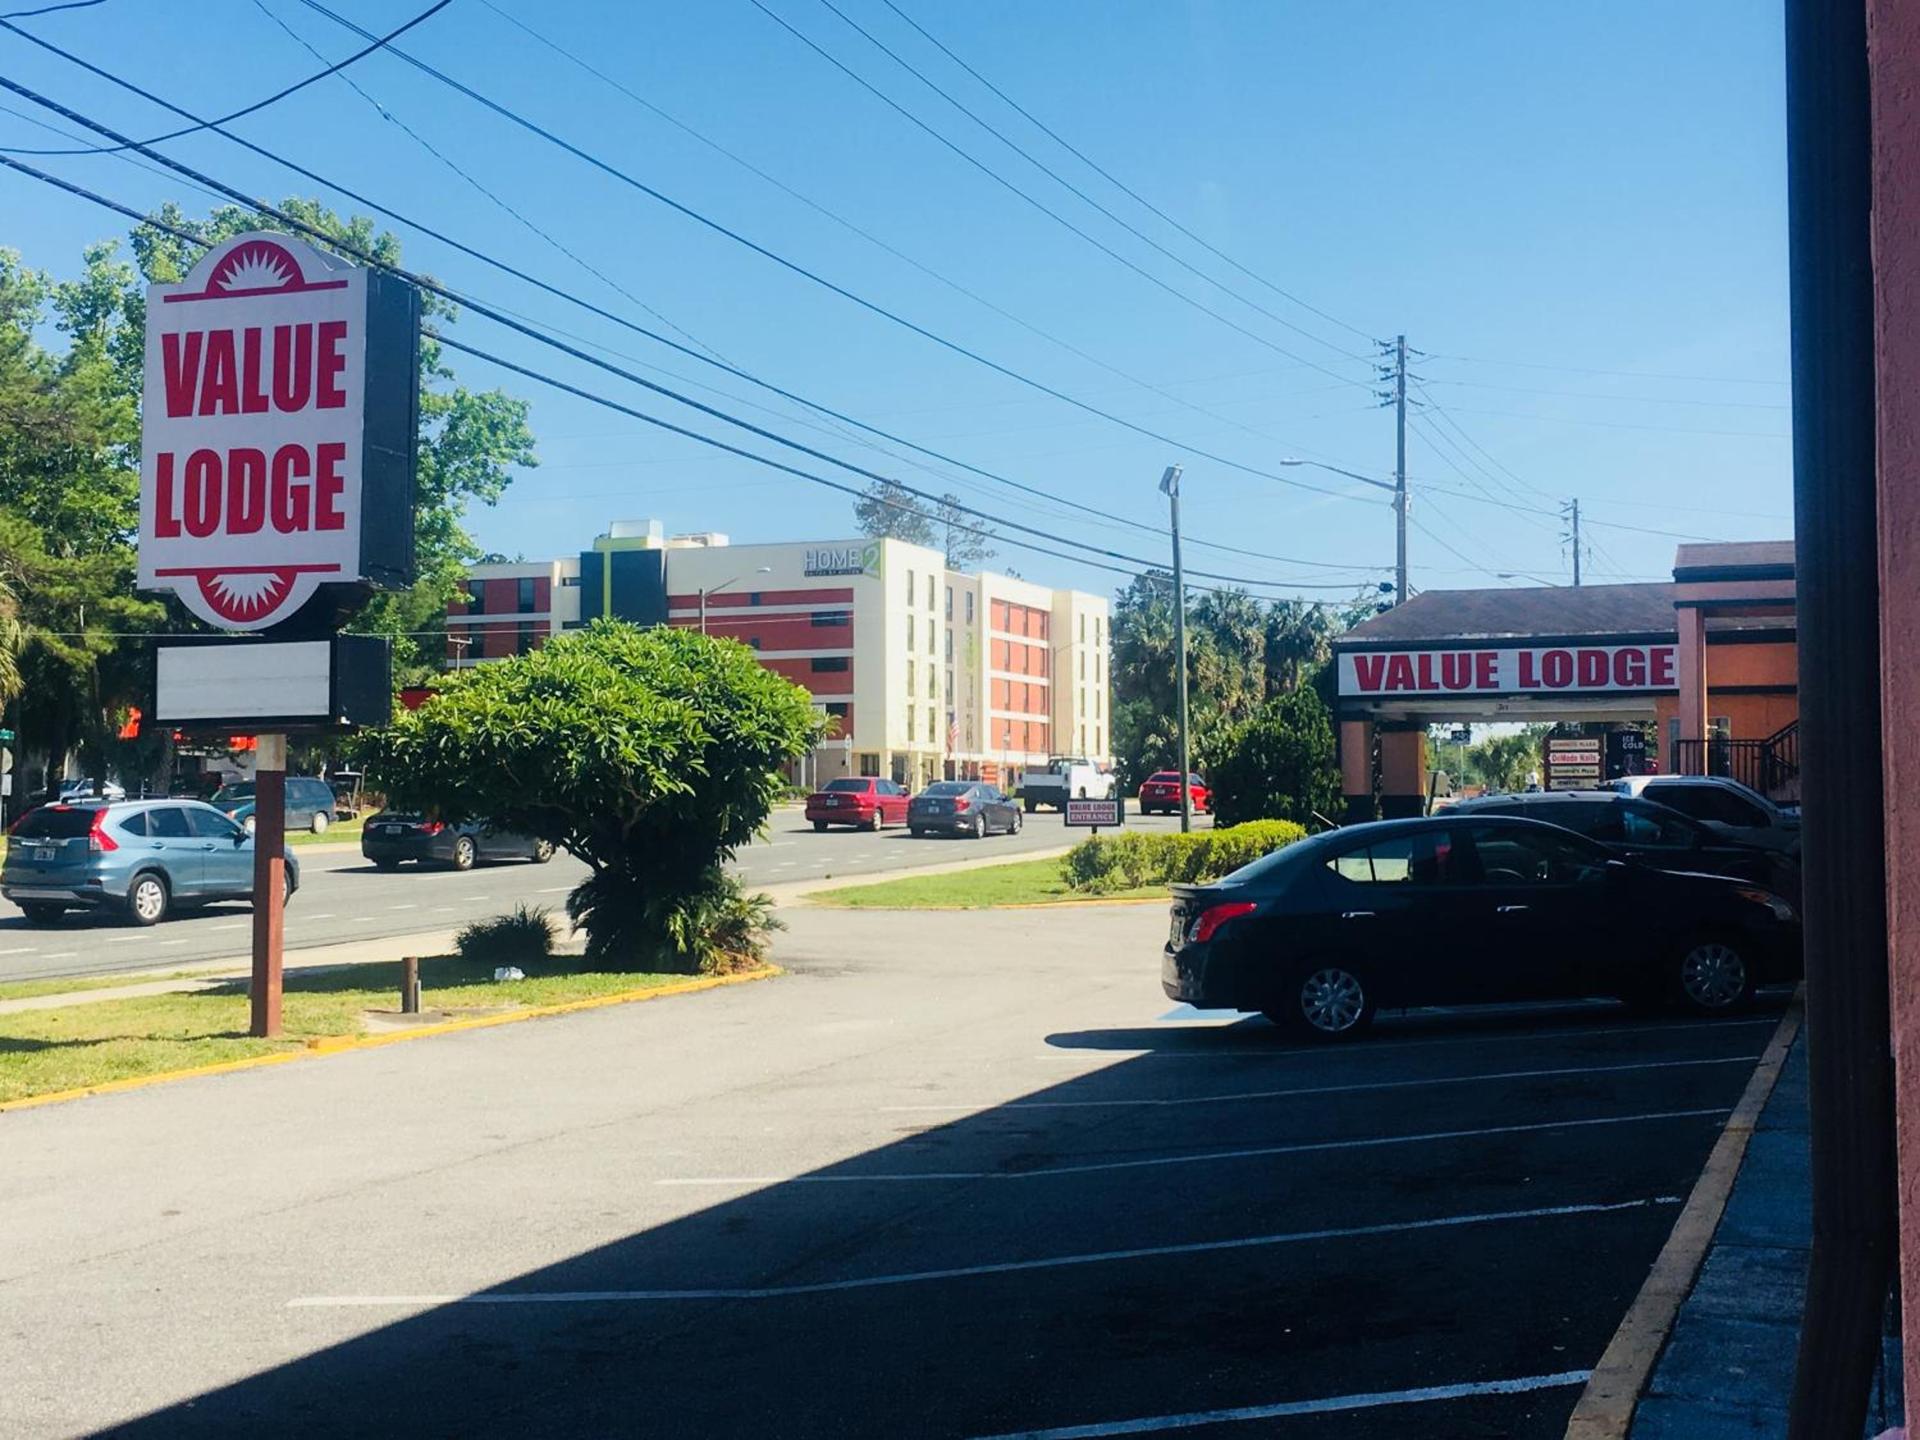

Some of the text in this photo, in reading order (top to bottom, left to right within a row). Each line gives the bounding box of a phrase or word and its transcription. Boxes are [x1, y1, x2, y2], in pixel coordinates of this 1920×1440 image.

[161, 320, 347, 418] VALUE
[154, 442, 346, 539] LODGE
[1354, 647, 1675, 691] VALUE LODGE
